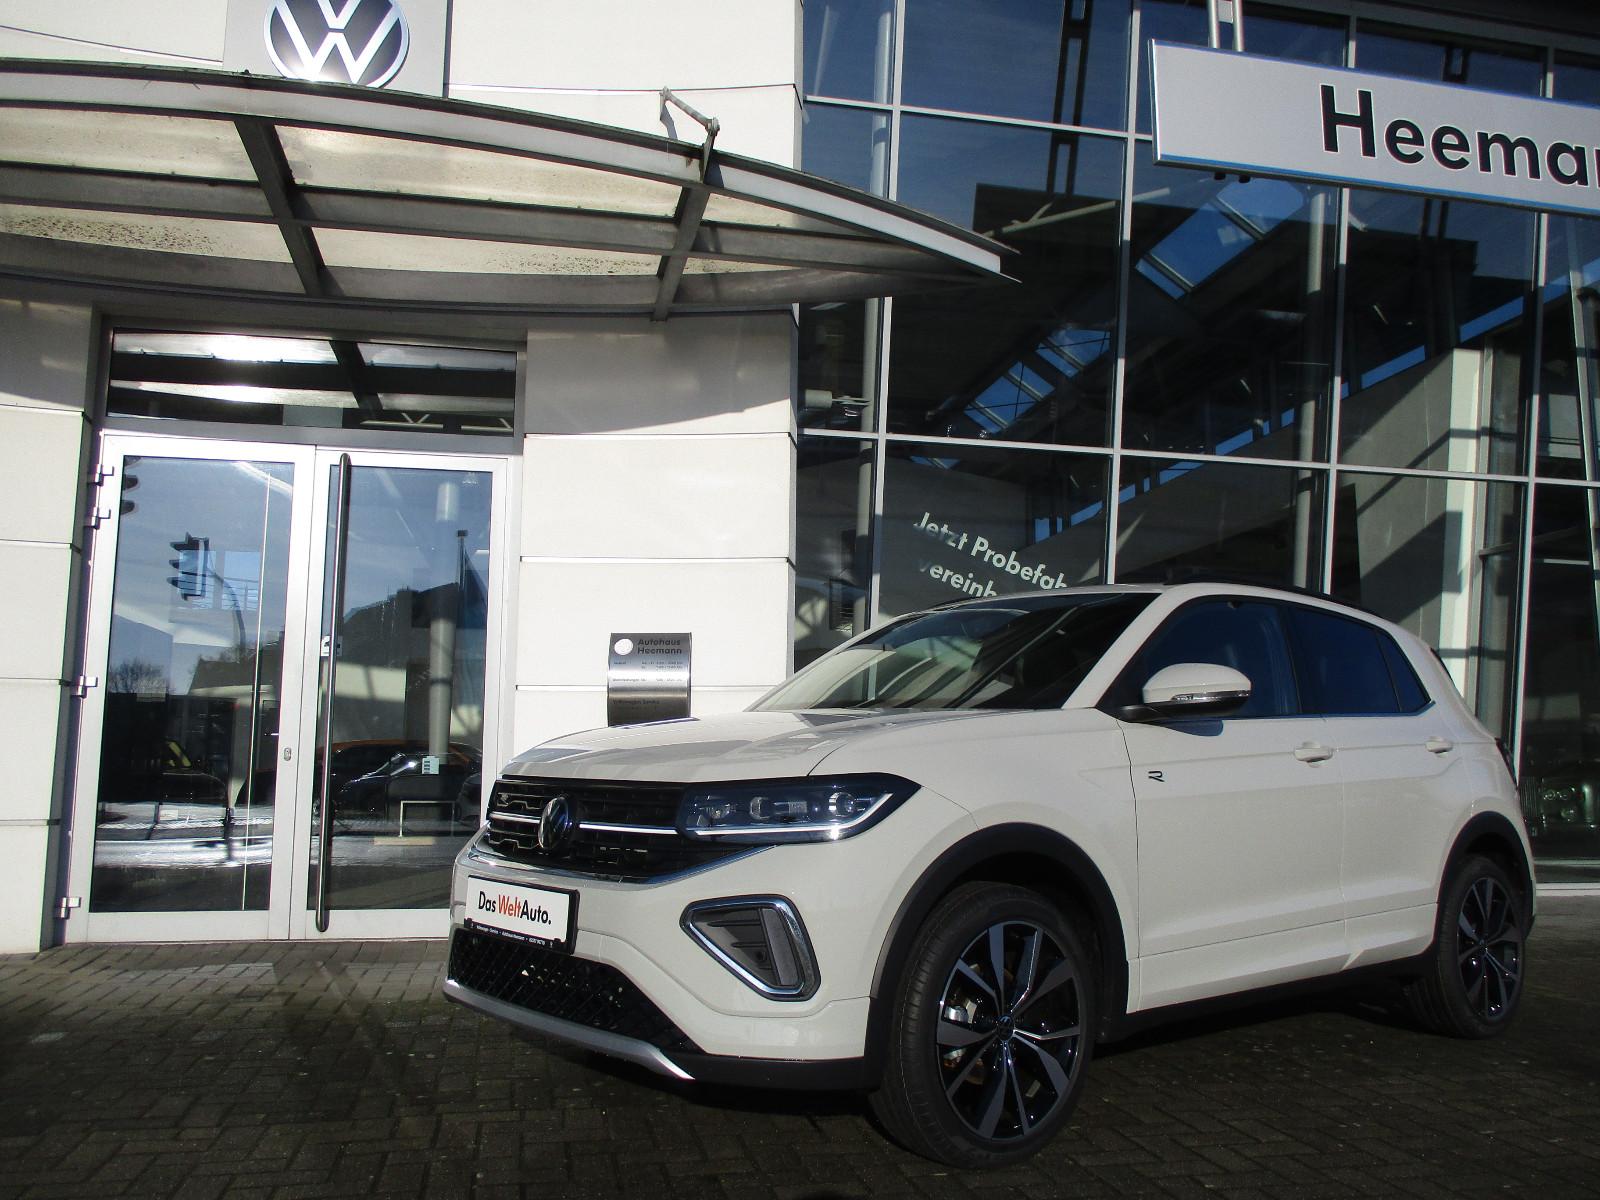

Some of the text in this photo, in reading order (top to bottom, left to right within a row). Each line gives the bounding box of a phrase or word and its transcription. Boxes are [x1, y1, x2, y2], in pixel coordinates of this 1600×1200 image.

[1320, 84, 1600, 189] Heema
[637, 638, 681, 646] Autohaus
[478, 890, 552, 925] Das WeltAuto.
